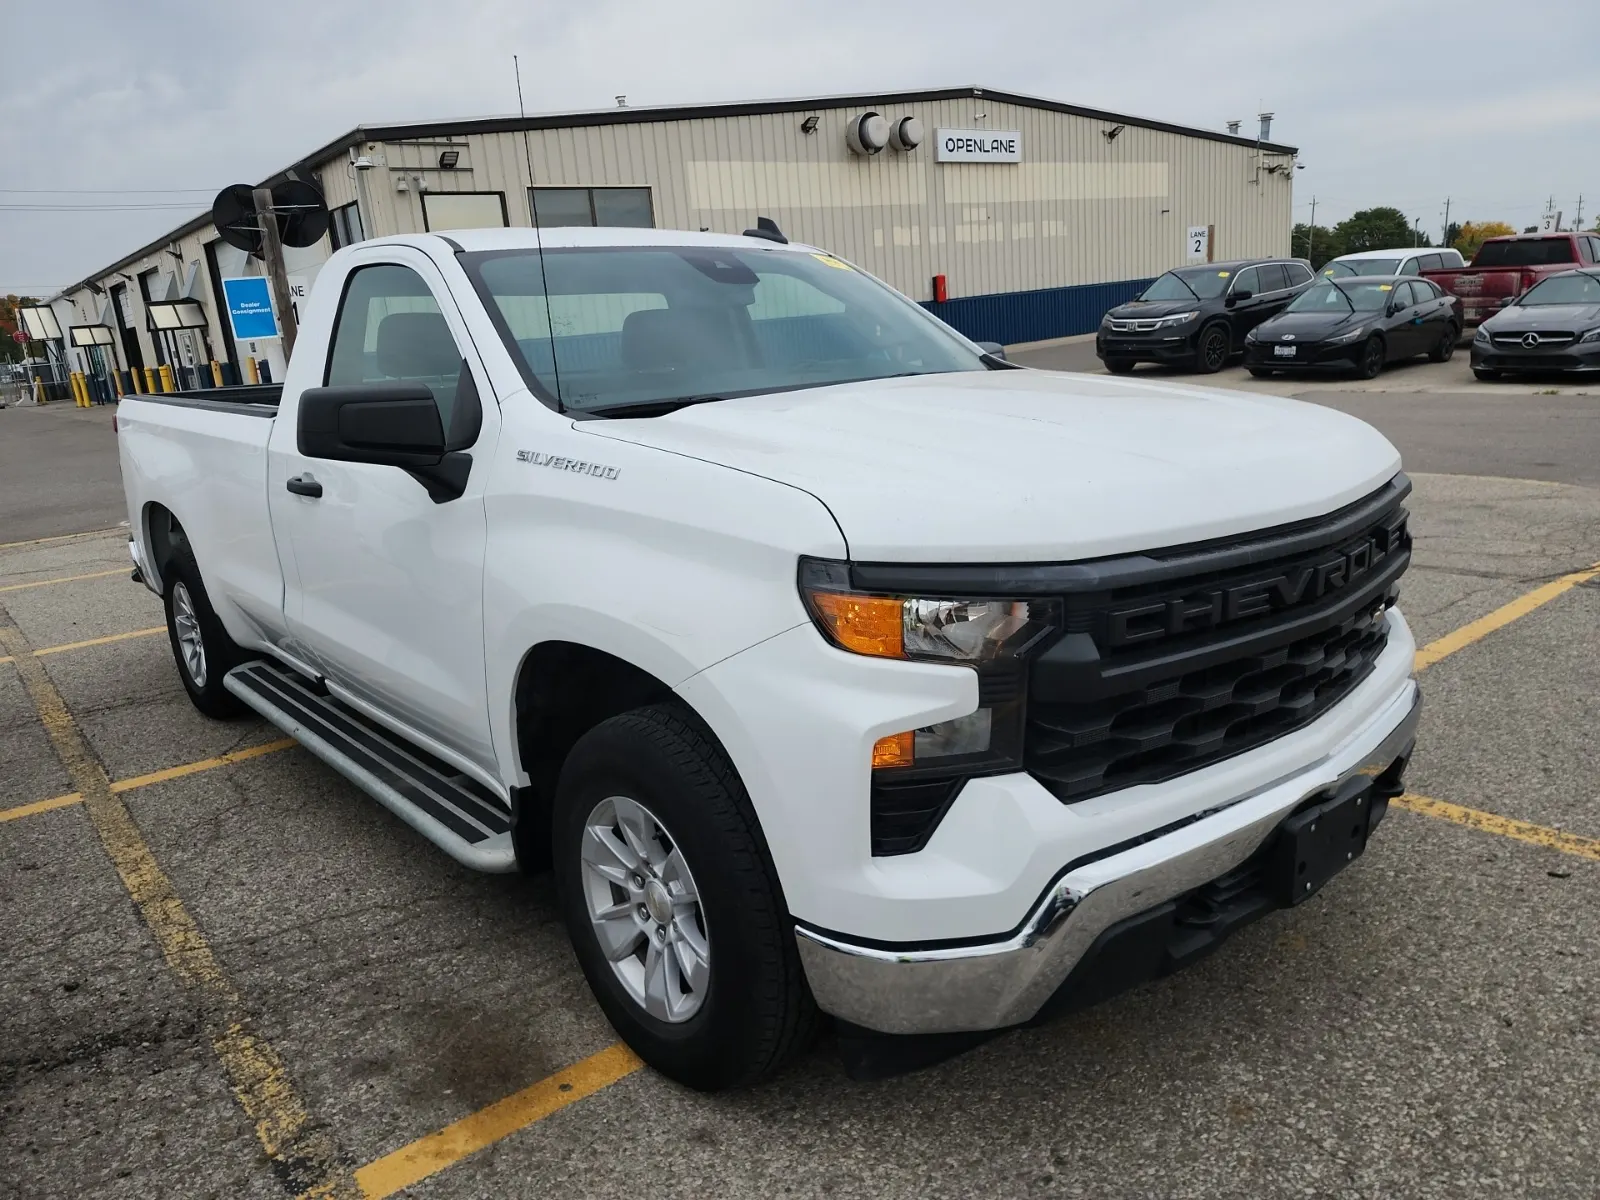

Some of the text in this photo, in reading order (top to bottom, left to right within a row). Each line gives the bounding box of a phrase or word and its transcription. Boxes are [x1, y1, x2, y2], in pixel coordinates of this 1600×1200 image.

[945, 137, 1016, 153] OPENLANE
[1544, 220, 1551, 230] 3
[1190, 231, 1206, 239] LANE
[1194, 239, 1202, 253] 2
[232, 307, 271, 315] Consignment
[516, 449, 622, 480] SILVERADO
